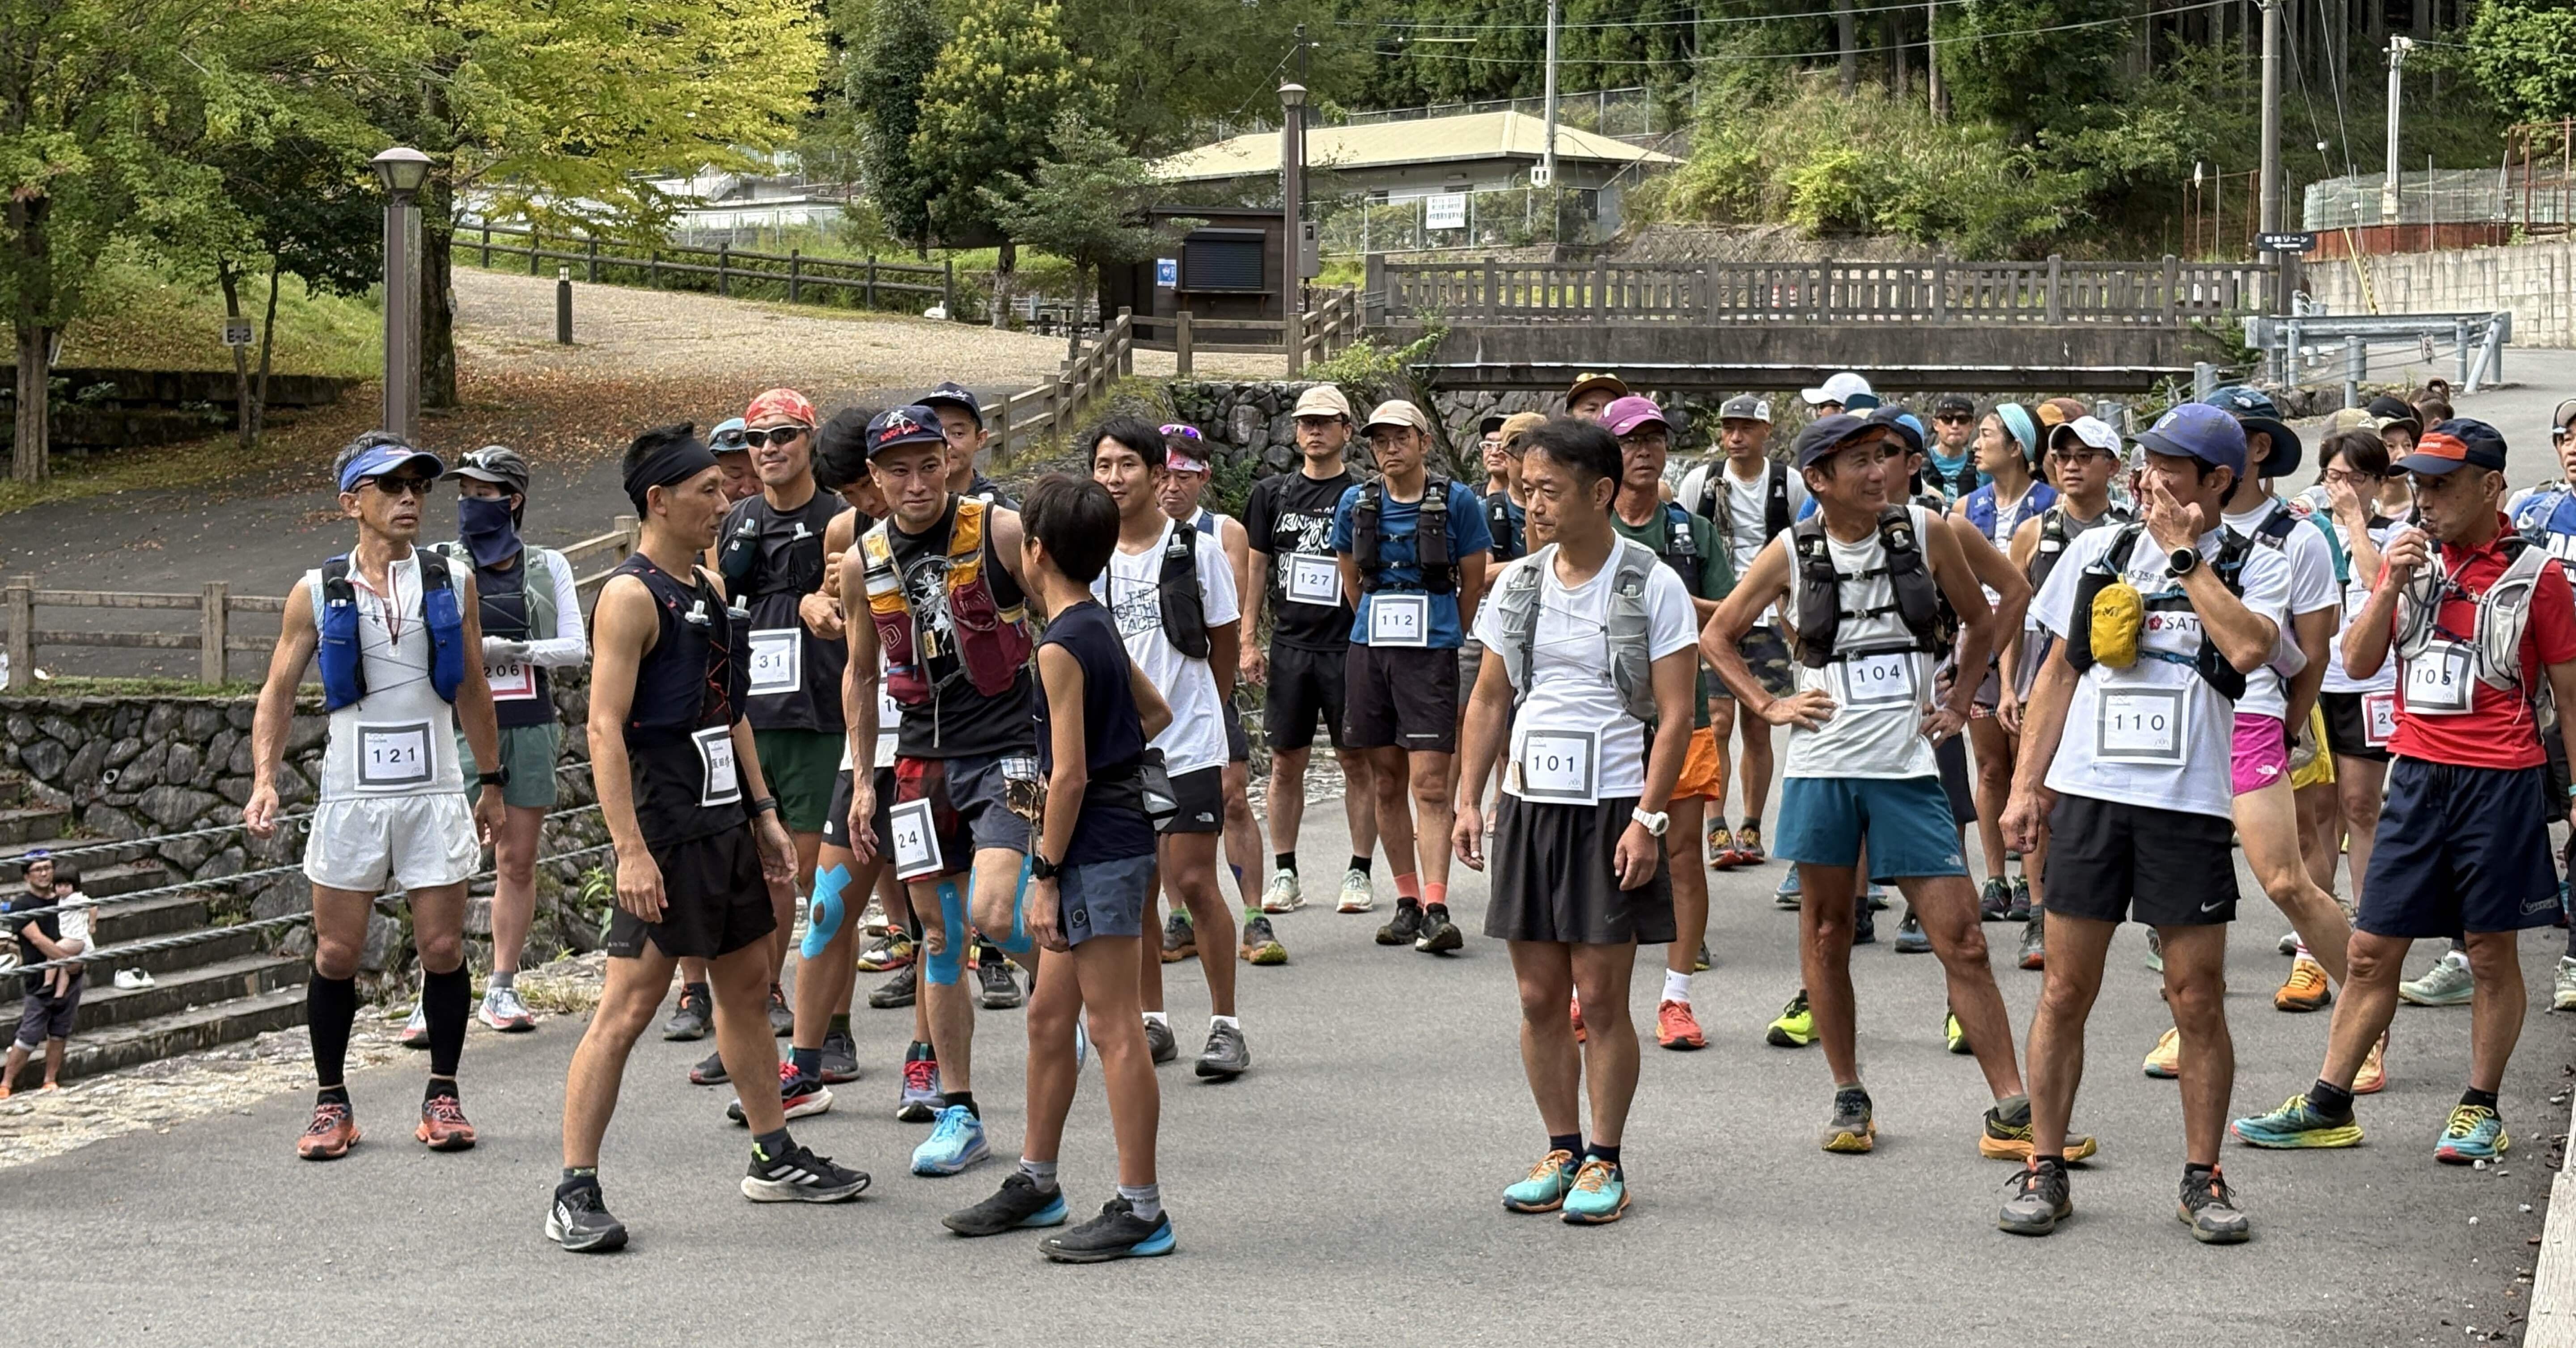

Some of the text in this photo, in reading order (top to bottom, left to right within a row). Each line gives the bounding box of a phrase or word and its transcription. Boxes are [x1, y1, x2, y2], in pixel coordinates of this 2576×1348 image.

[1301, 572, 1330, 586] 127
[1381, 614, 1413, 626] 112
[483, 664, 520, 678] 206
[1856, 664, 1900, 683] 104
[2415, 668, 2452, 685] 105
[2114, 714, 2165, 731] 110
[373, 746, 415, 764] 121
[1533, 755, 1574, 773] 101
[898, 830, 918, 849] 24
